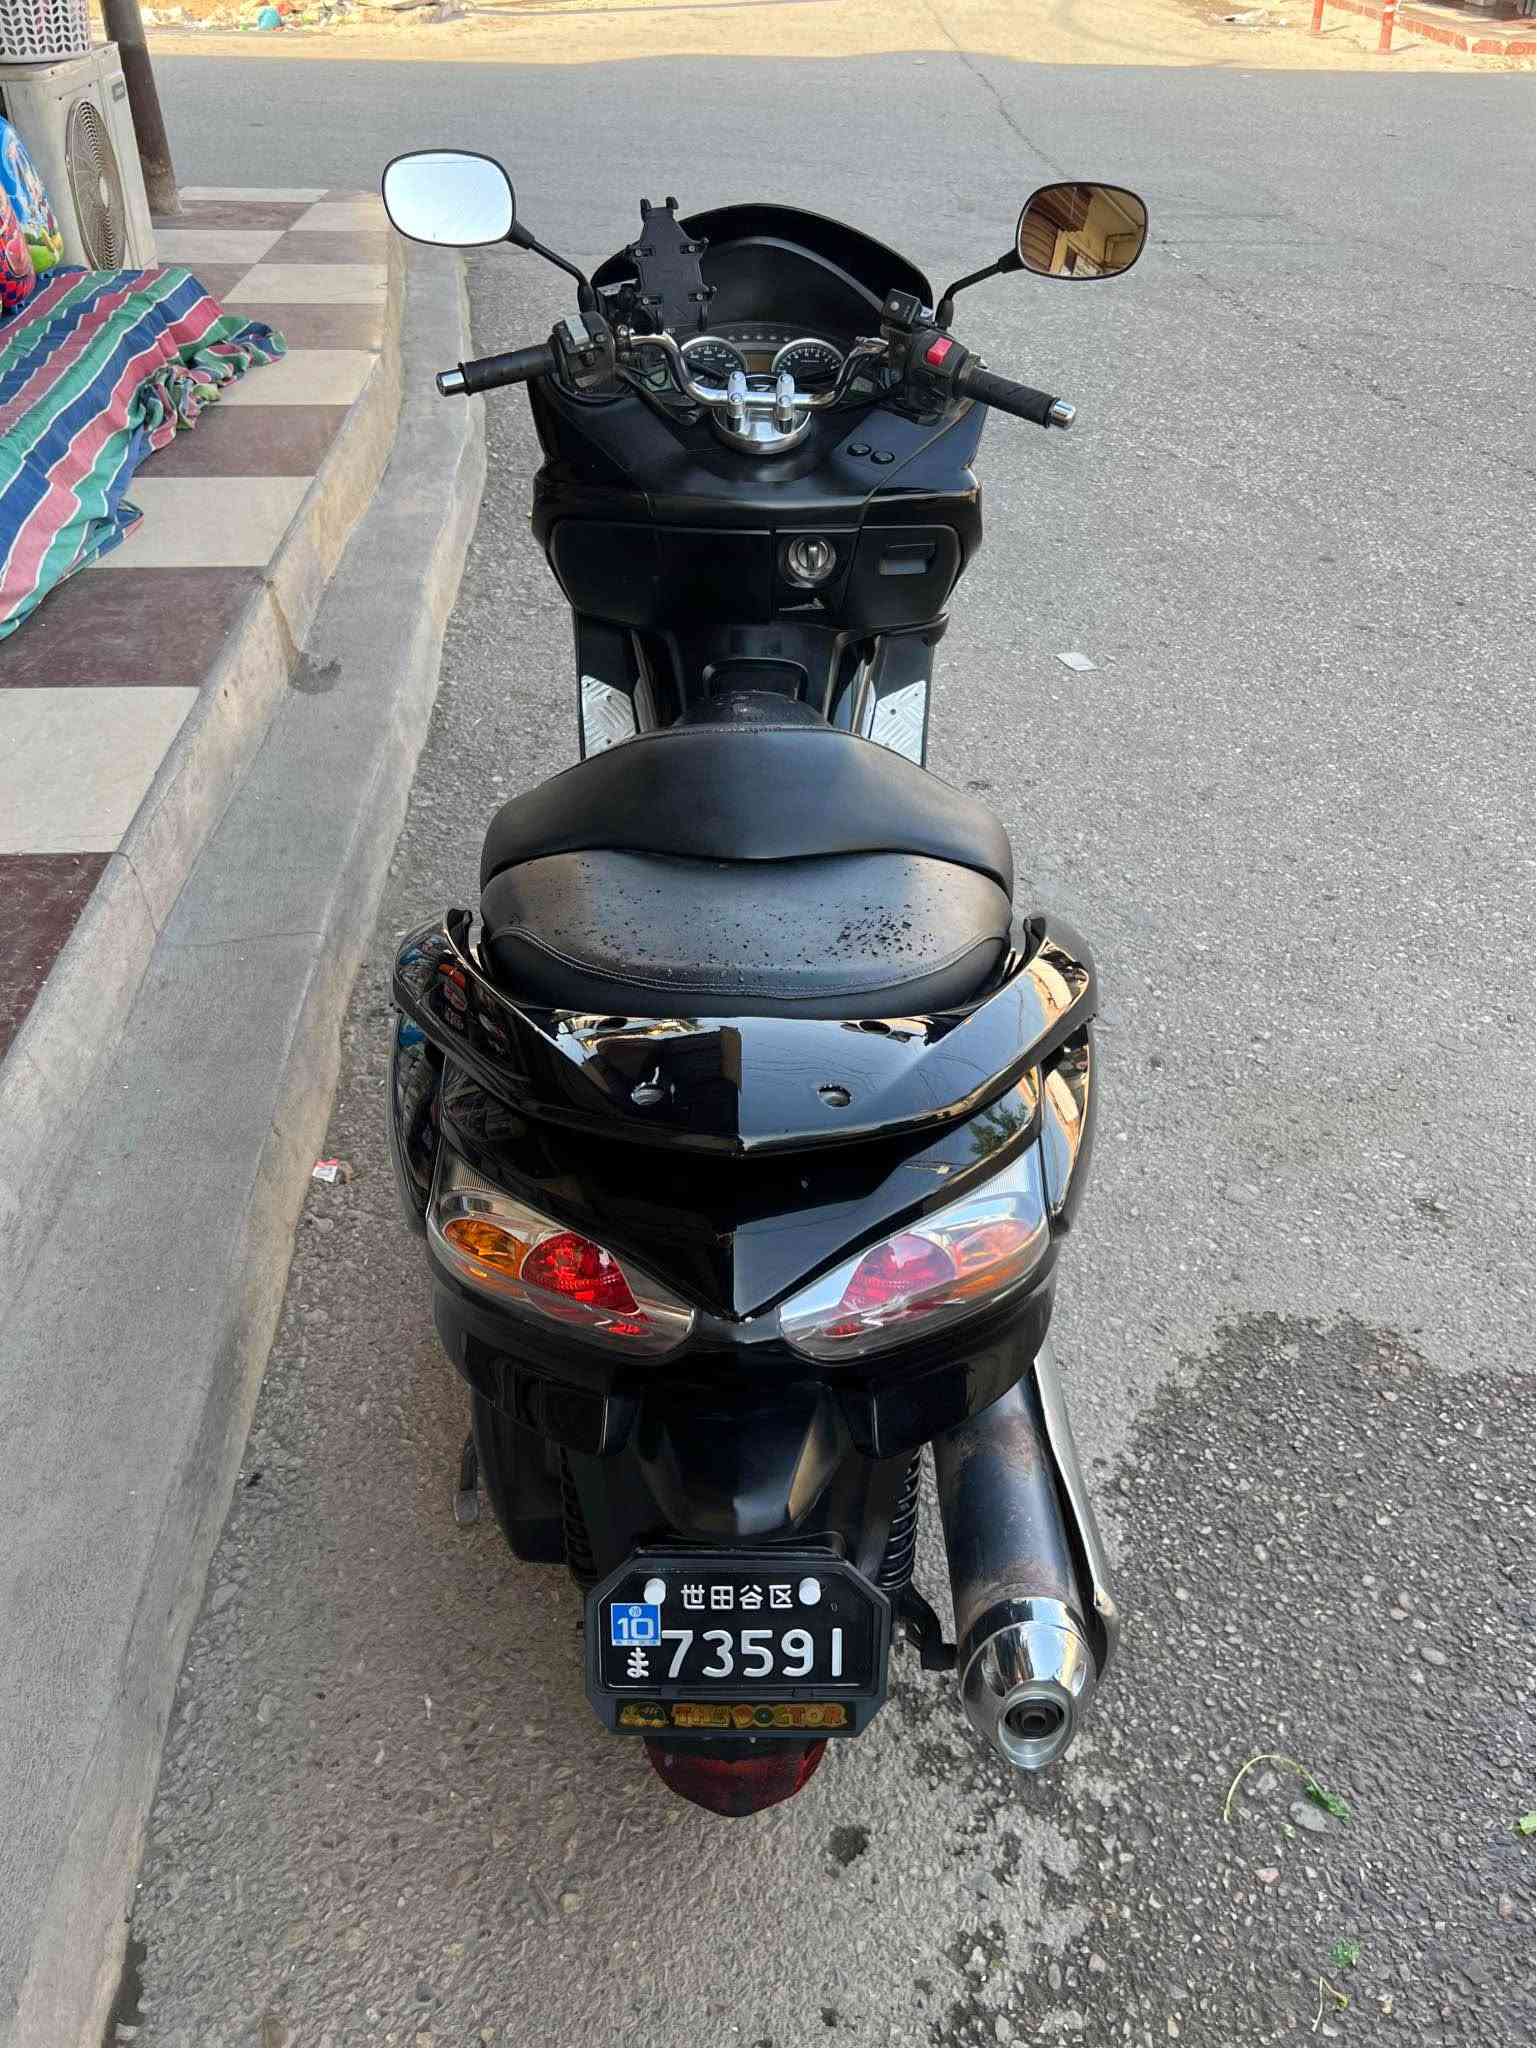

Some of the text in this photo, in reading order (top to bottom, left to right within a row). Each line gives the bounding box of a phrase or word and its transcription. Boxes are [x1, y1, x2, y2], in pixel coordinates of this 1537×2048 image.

[681, 1584, 793, 1610] 世田谷区
[617, 1617, 654, 1639] 10
[627, 1627, 843, 1679] ま 73591
